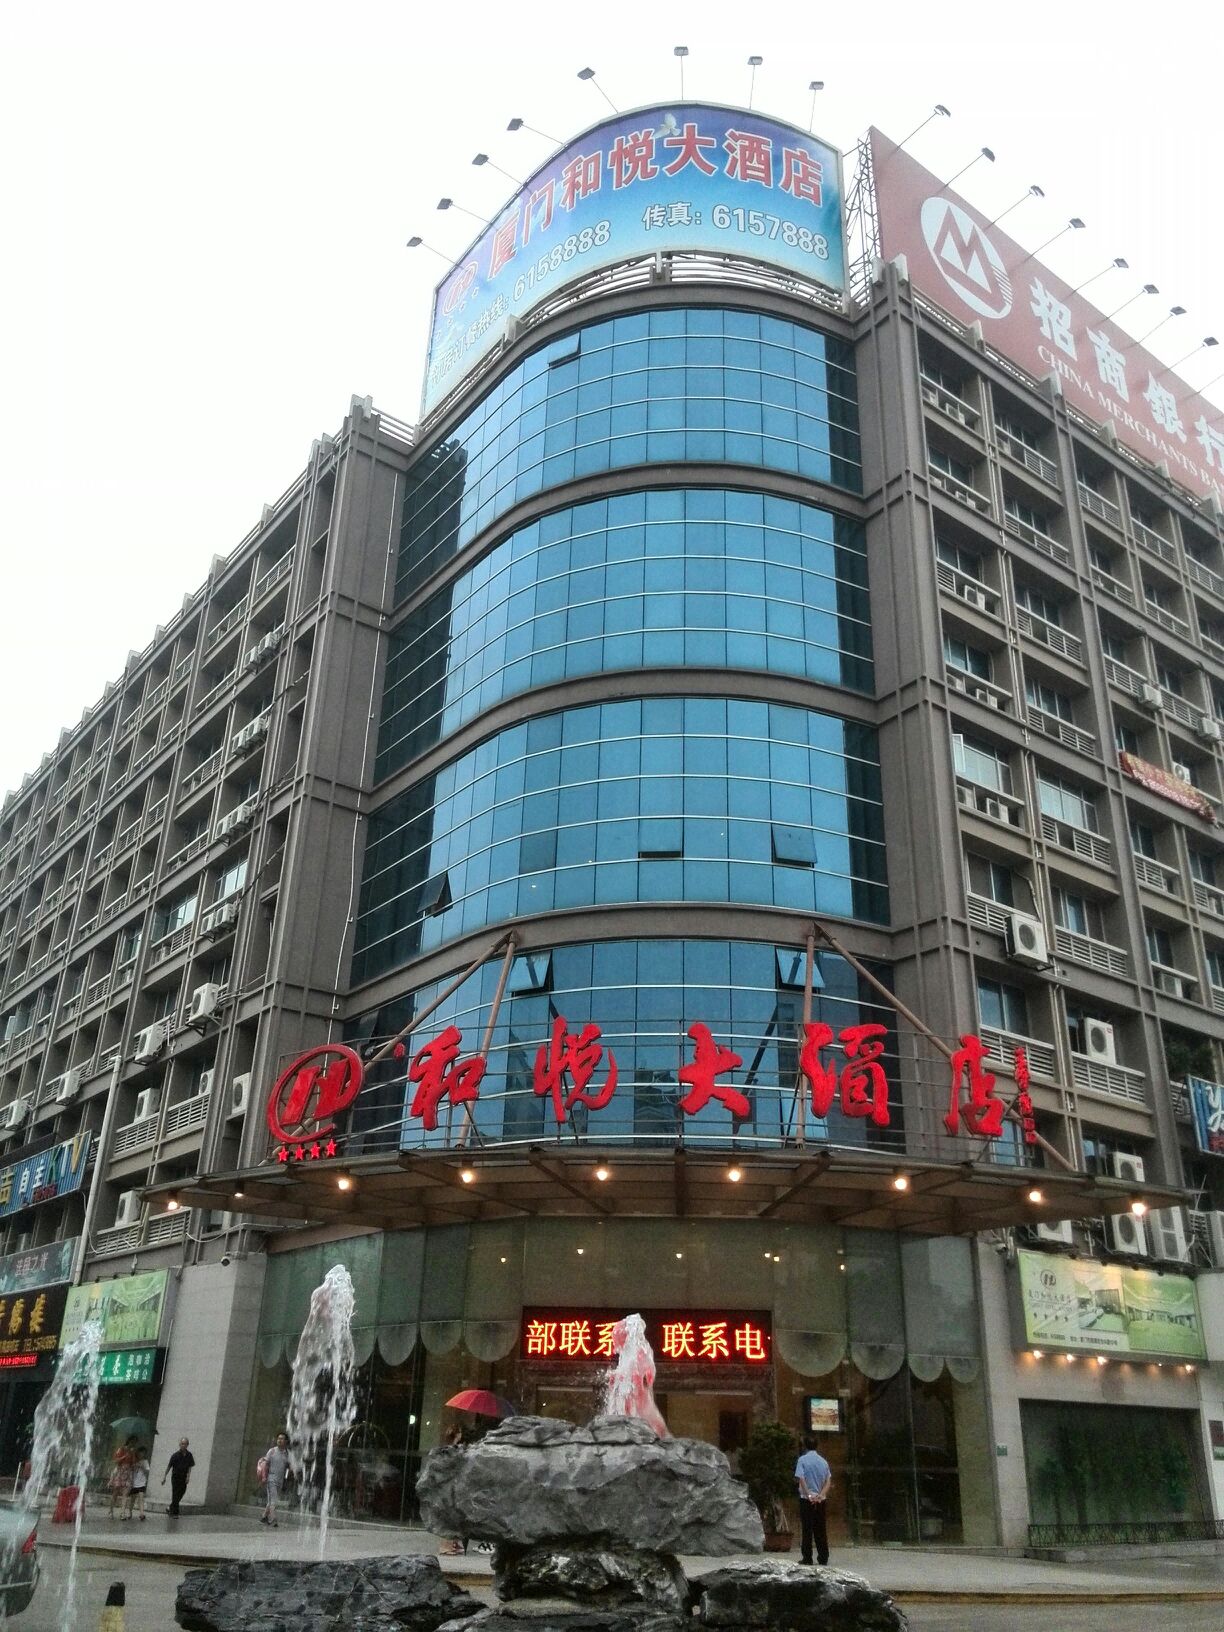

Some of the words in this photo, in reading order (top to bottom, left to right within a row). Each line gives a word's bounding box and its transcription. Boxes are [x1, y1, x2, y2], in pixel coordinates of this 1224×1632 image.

[488, 123, 824, 279] 厦门和悦大酒店
[513, 219, 612, 301] 6158888
[642, 201, 702, 231] 传真:
[711, 203, 830, 261] 6157888
[1037, 344, 1095, 399] CHINA
[1098, 390, 1198, 477] MERCHANTS
[1201, 471, 1224, 496] BA
[408, 1016, 1005, 1137] 和悦大酒店
